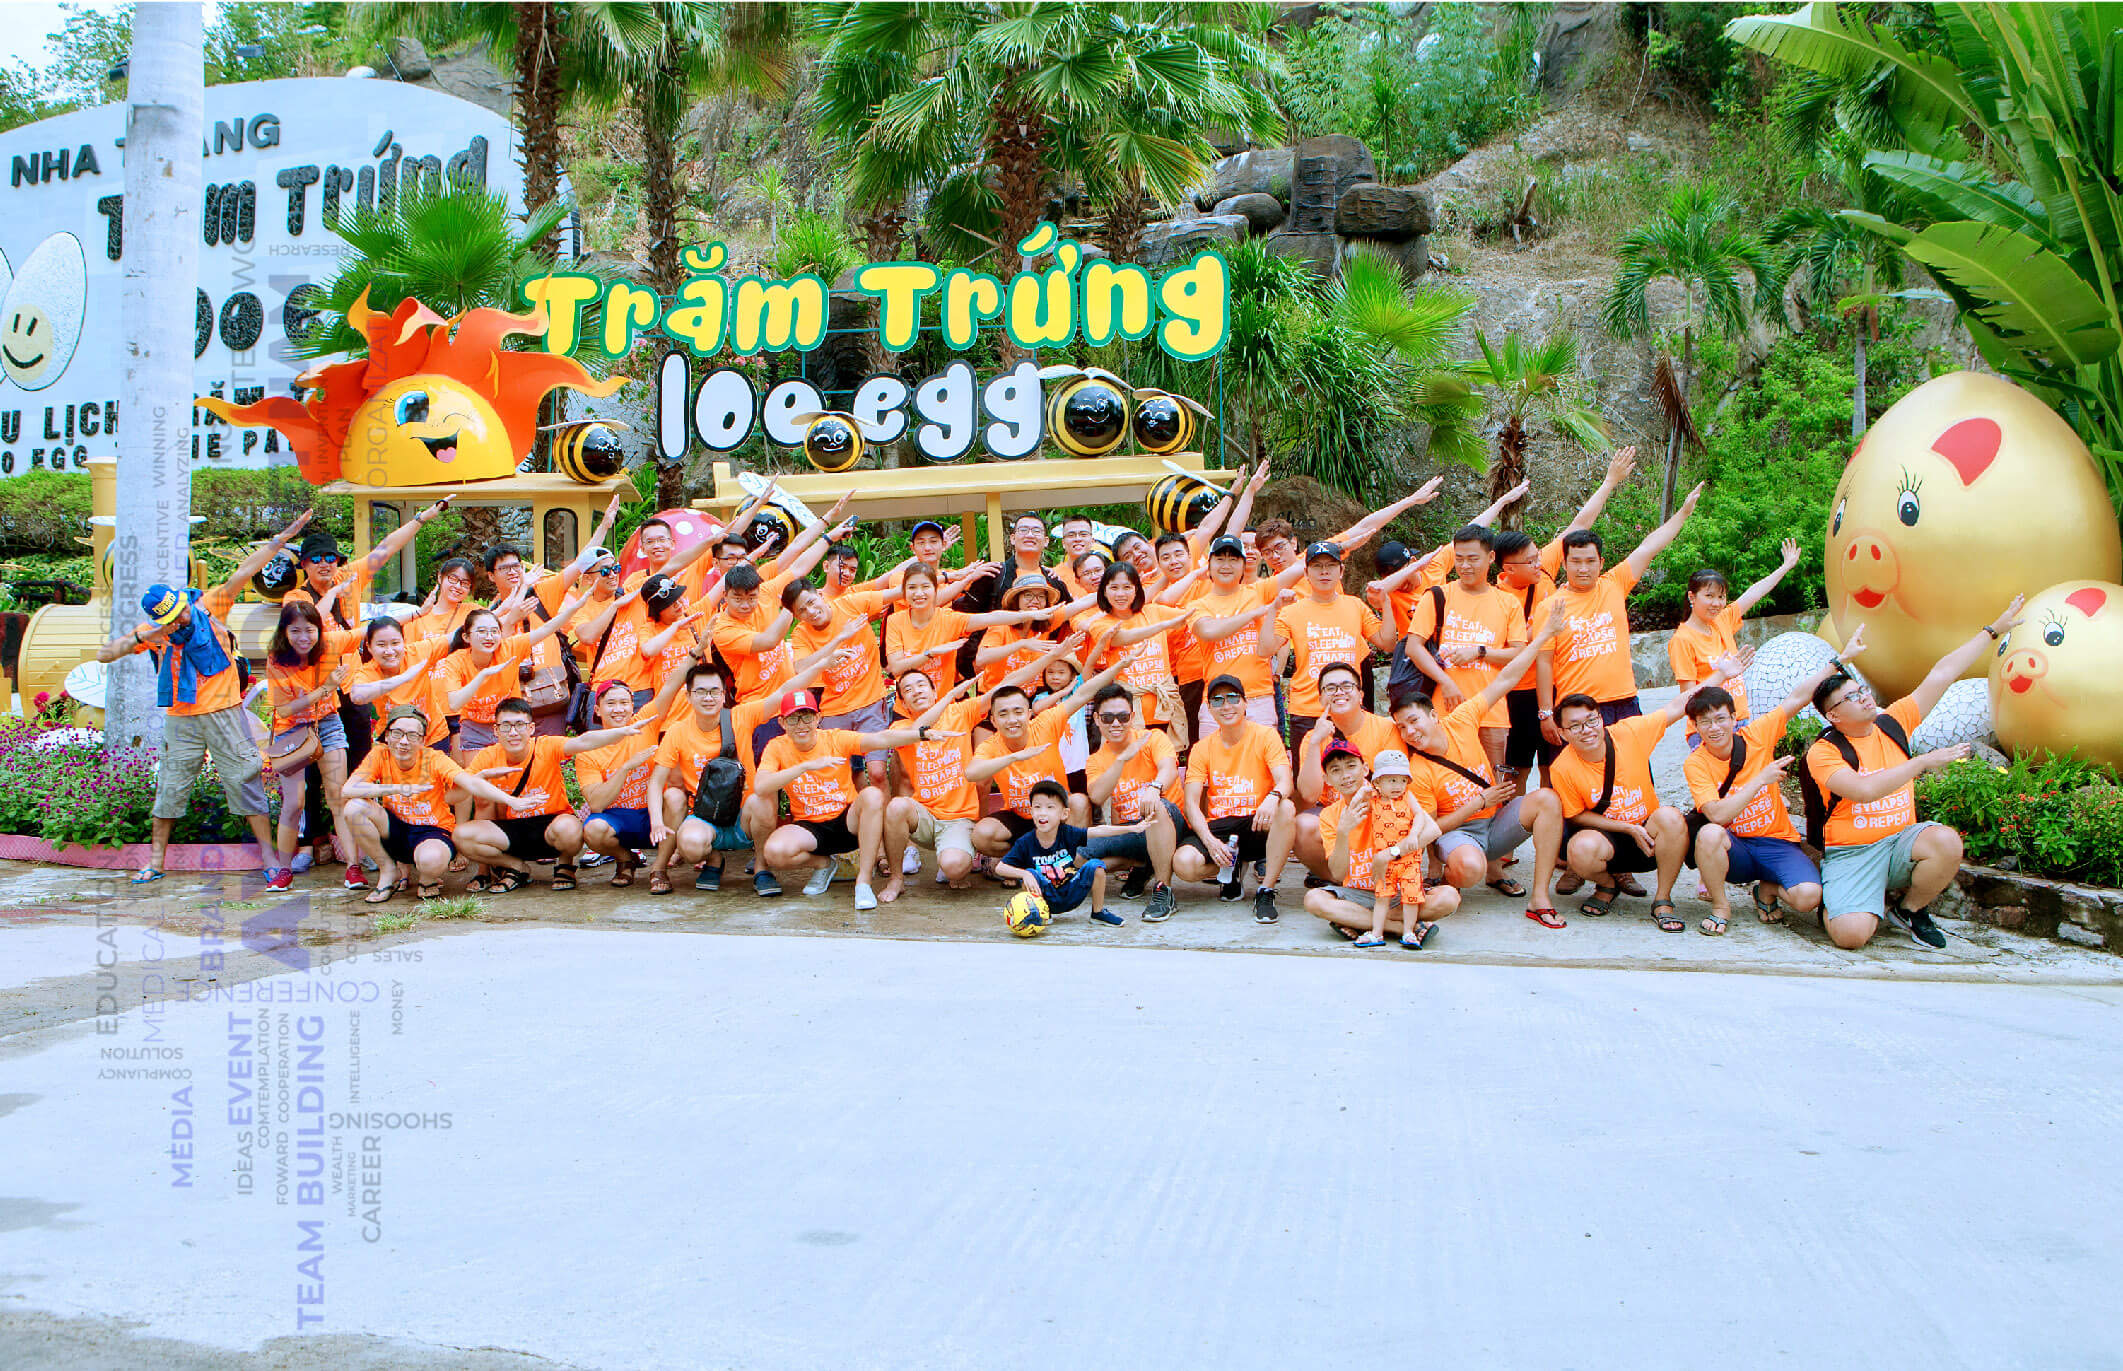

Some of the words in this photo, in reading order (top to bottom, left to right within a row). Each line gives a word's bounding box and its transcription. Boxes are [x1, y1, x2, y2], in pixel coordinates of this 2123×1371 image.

[11, 144, 101, 188] NHA
[519, 240, 829, 360] Trăm
[854, 221, 1231, 361] Trứng
[850, 359, 1047, 462] egg
[1869, 809, 1910, 828] REPEAT
